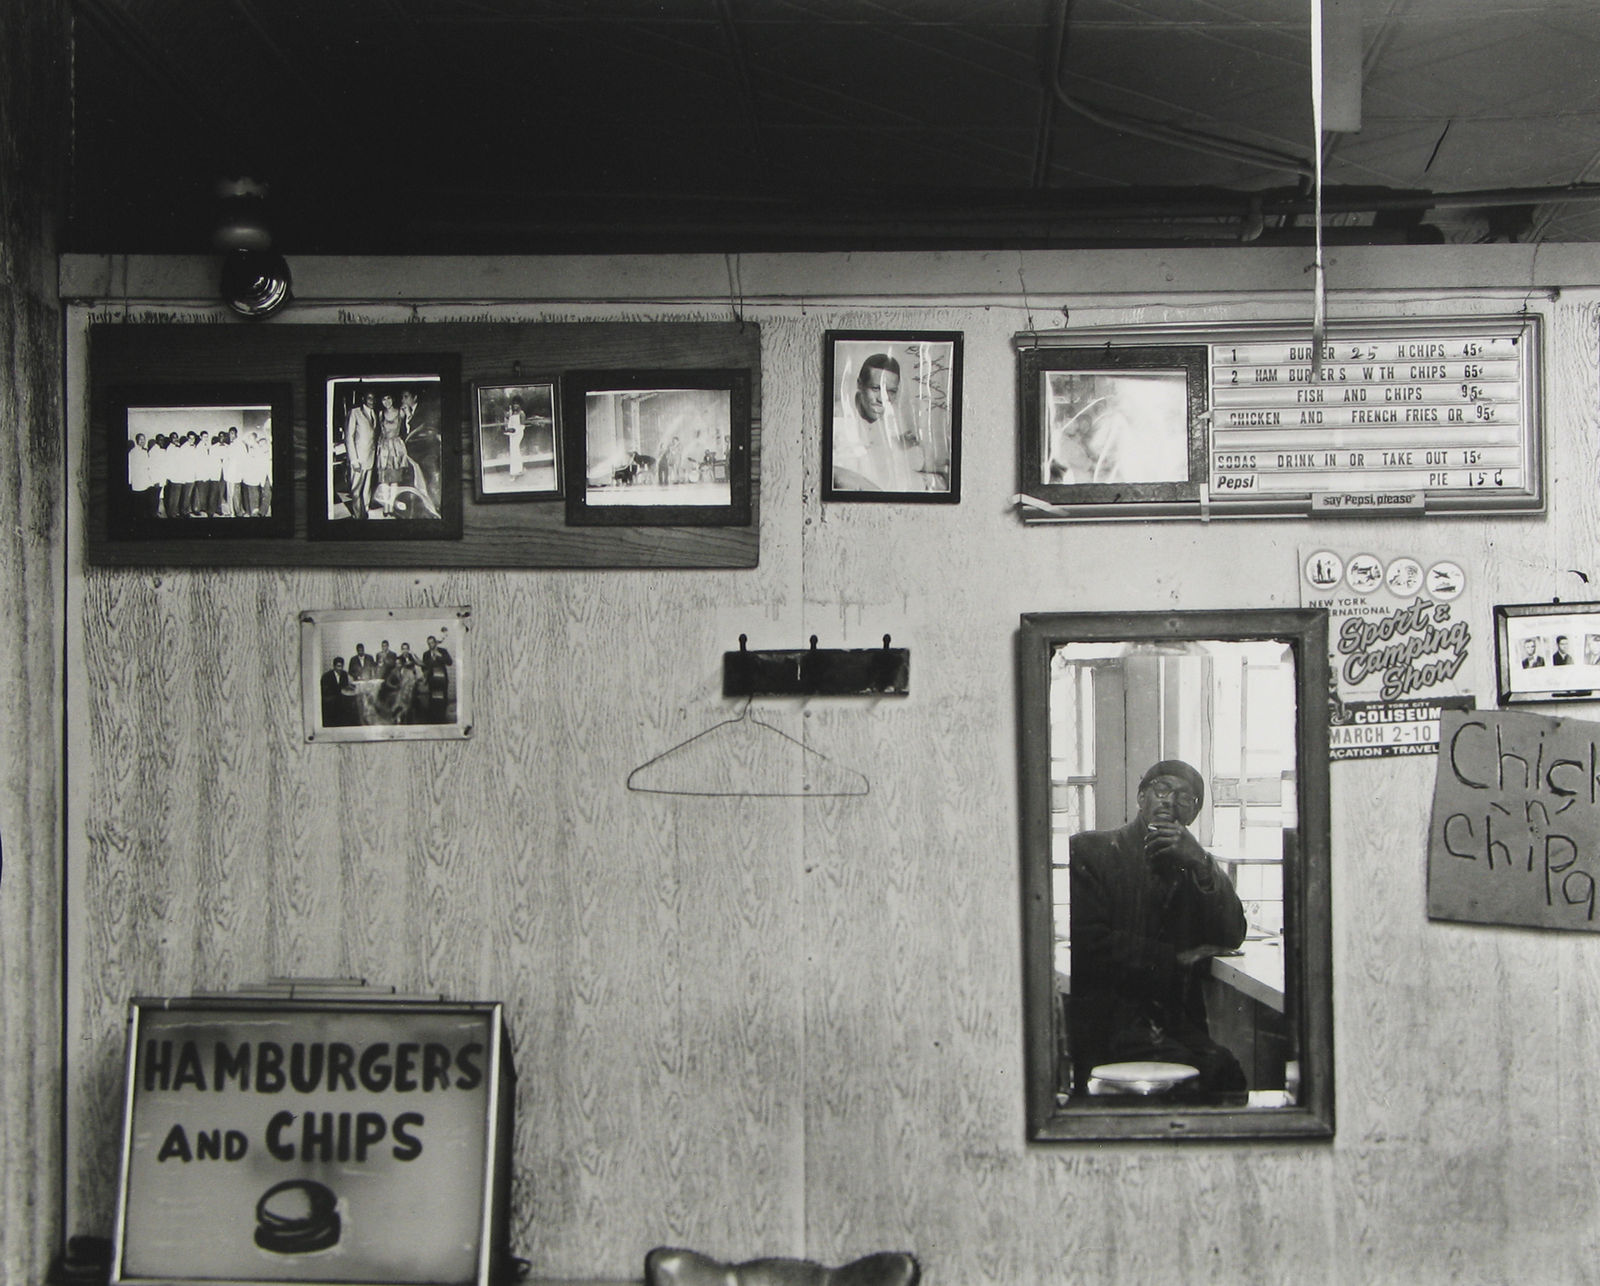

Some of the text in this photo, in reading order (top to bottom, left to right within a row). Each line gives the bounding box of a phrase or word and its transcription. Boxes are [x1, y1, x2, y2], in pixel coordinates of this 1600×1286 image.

[1231, 348, 1237, 362] 1
[1289, 347, 1335, 361] BURER
[1350, 345, 1379, 361] 25
[1463, 343, 1483, 357] 45¢
[1231, 370, 1238, 383] 2
[1410, 365, 1446, 379] CHIPS
[1464, 364, 1484, 378] 65¢
[1297, 389, 1324, 402] FISH
[1344, 388, 1367, 402] AND
[1385, 387, 1422, 401] CHIPS
[1230, 412, 1280, 426] CHICKEN
[1300, 411, 1323, 424] AND
[1352, 409, 1397, 423] FRENCH
[1406, 408, 1438, 421] FRIES
[1448, 408, 1463, 421] OR
[1217, 450, 1482, 469] SODAS DRINK IN OR TAKE OUT 15¢
[1217, 475, 1254, 490] Pepsi
[1429, 472, 1448, 486] PIE
[1309, 597, 1367, 608] NEW YORK
[1338, 597, 1450, 654] Sport &
[1343, 621, 1471, 685] Camping
[1380, 651, 1468, 701] Show
[1354, 707, 1441, 724] COLISEUM
[1330, 725, 1431, 744] MARCH 2-10
[1330, 744, 1439, 759] ACATION TRAVEL
[143, 1039, 484, 1094] HAMBURGERS
[157, 1110, 425, 1163] AND CHIPS
